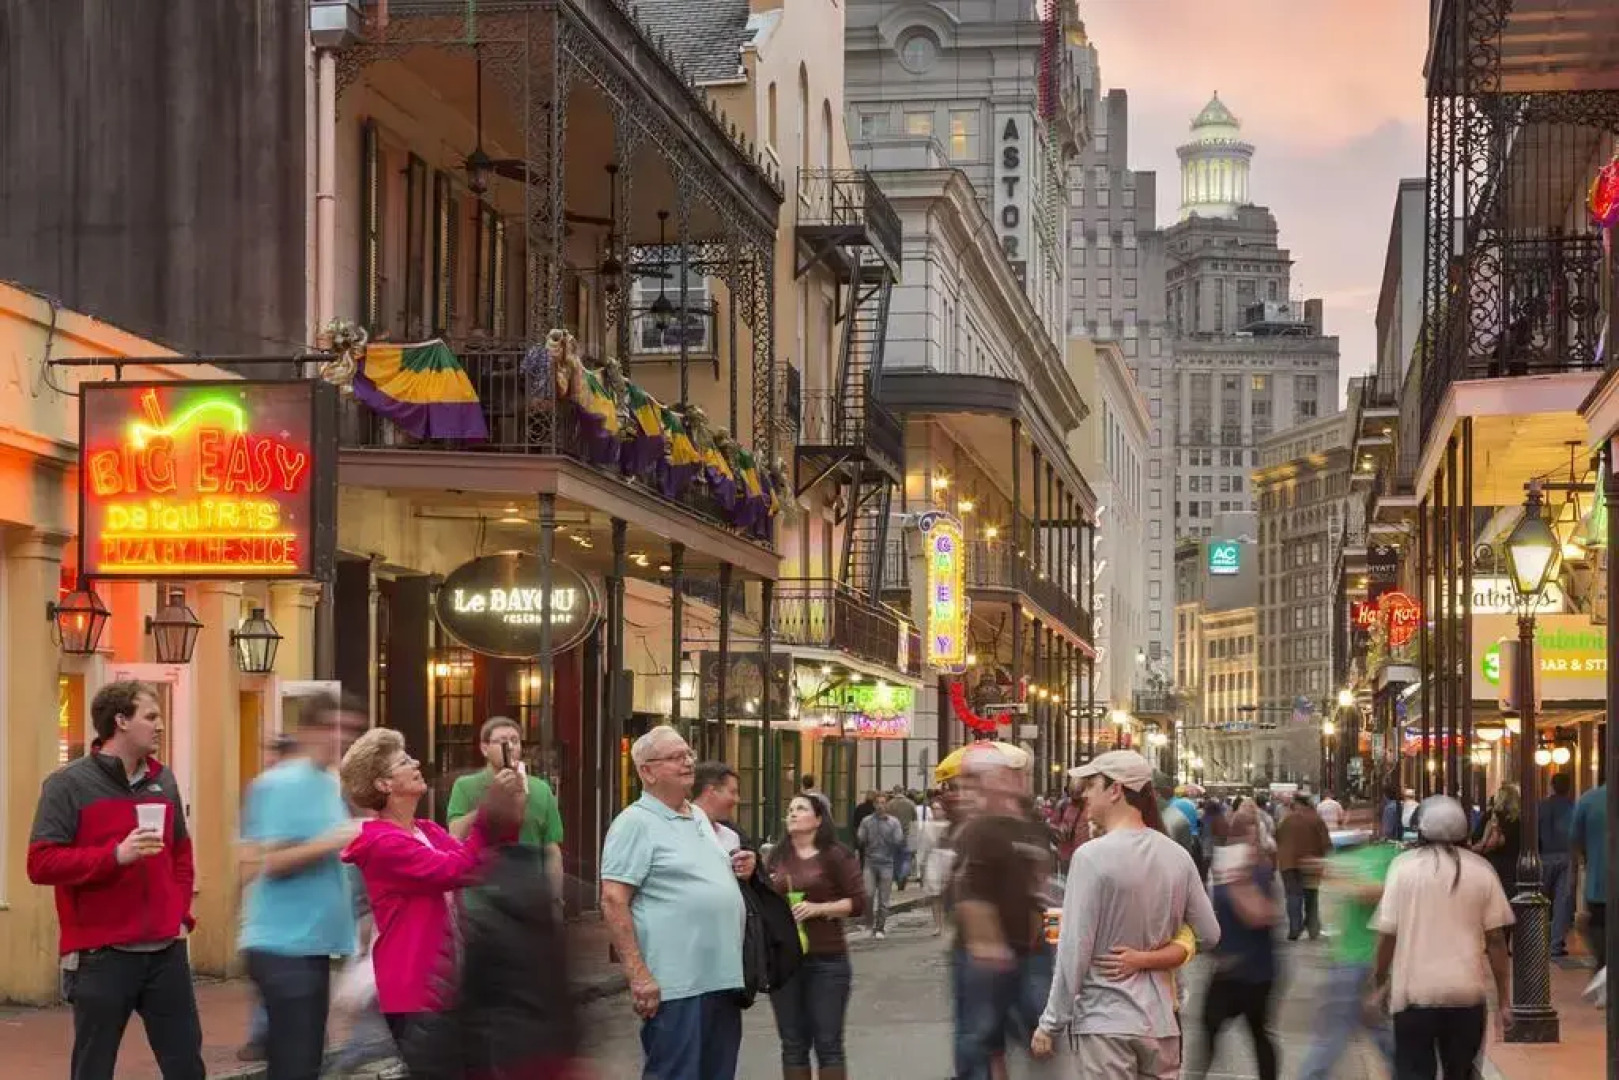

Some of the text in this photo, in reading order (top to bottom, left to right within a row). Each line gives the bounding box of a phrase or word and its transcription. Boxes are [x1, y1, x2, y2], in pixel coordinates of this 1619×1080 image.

[1002, 117, 1020, 257] ASTOR
[90, 427, 305, 496] BIG EASY
[103, 537, 295, 565] PIZZA BY THE SLICE
[1212, 546, 1236, 559] AC
[1368, 564, 1396, 573] HYATT
[454, 589, 485, 612] Le
[1540, 659, 1568, 671] BAR
[1570, 659, 1582, 671] &
